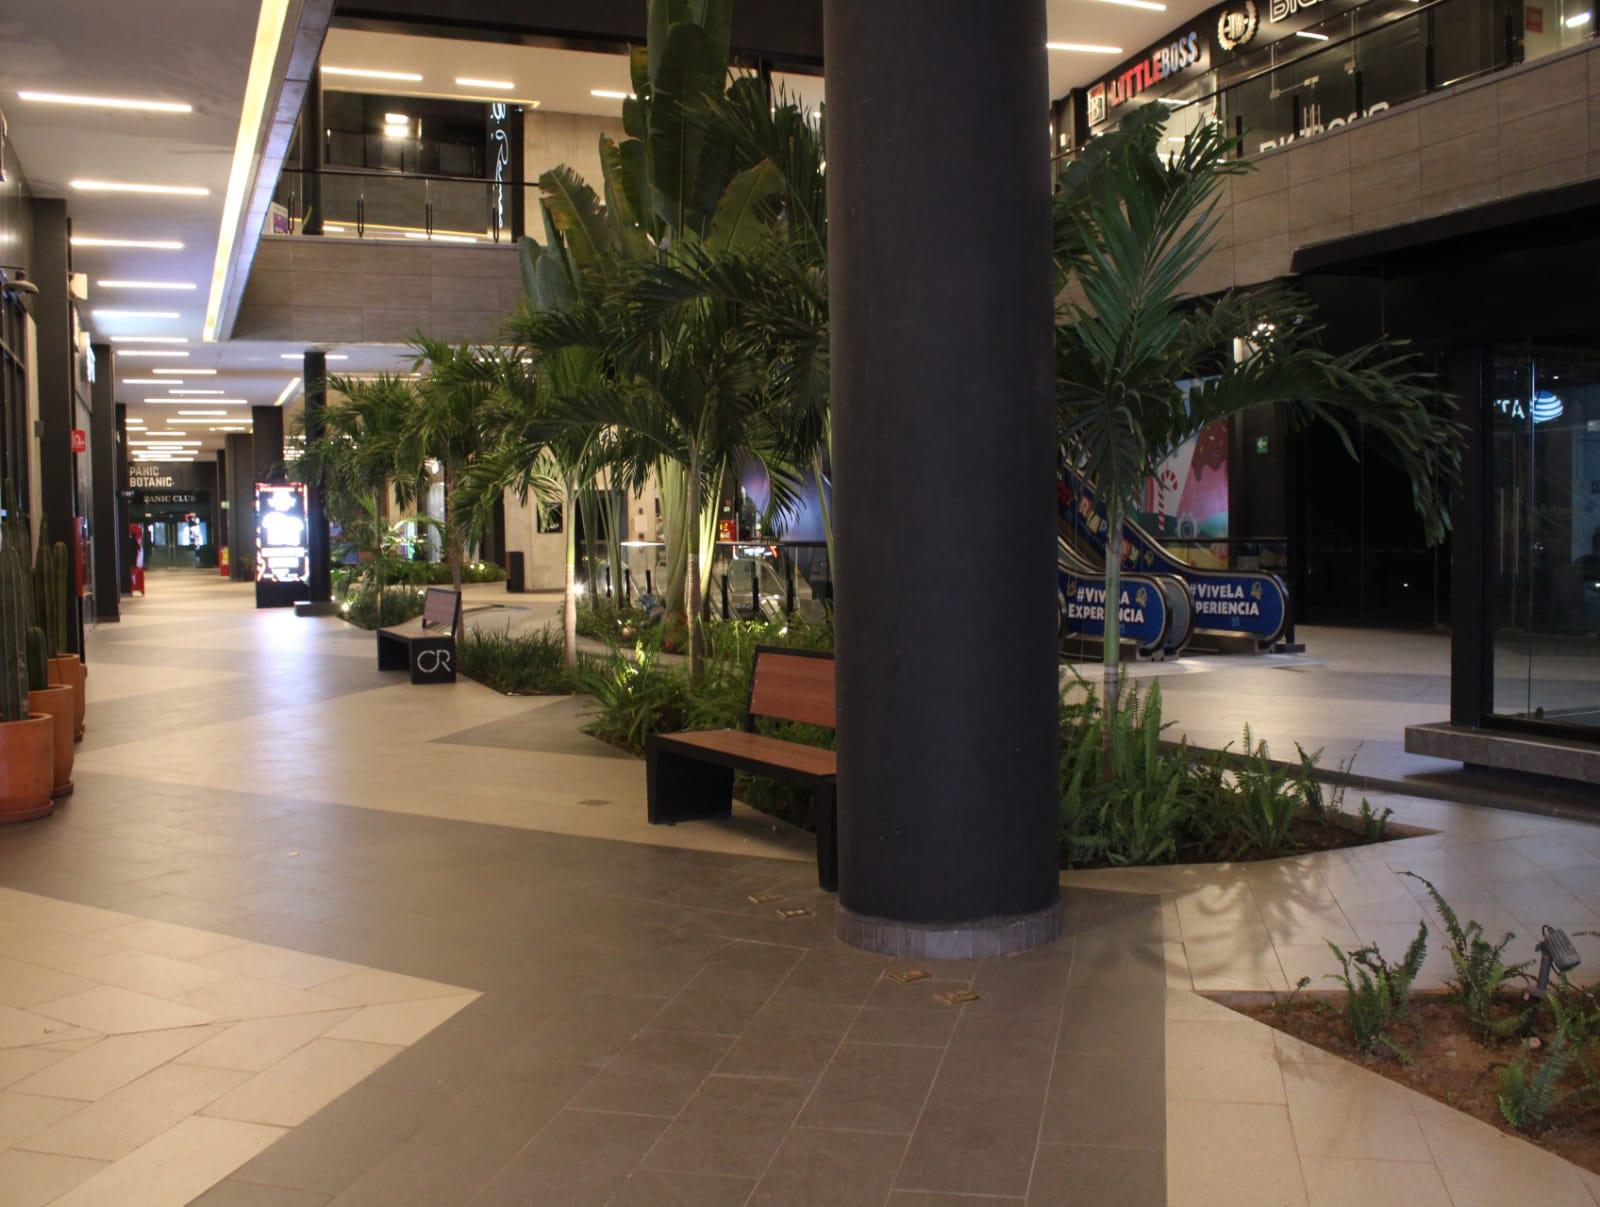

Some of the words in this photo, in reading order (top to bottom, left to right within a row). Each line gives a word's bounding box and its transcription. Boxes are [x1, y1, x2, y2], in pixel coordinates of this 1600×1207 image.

[129, 466, 160, 477] PANIC
[129, 476, 173, 488] BOTANIC
[1076, 587, 1130, 605] #VIVA
[1067, 603, 1145, 624] EXPERCIA
[1195, 601, 1260, 616] PERIENCIA
